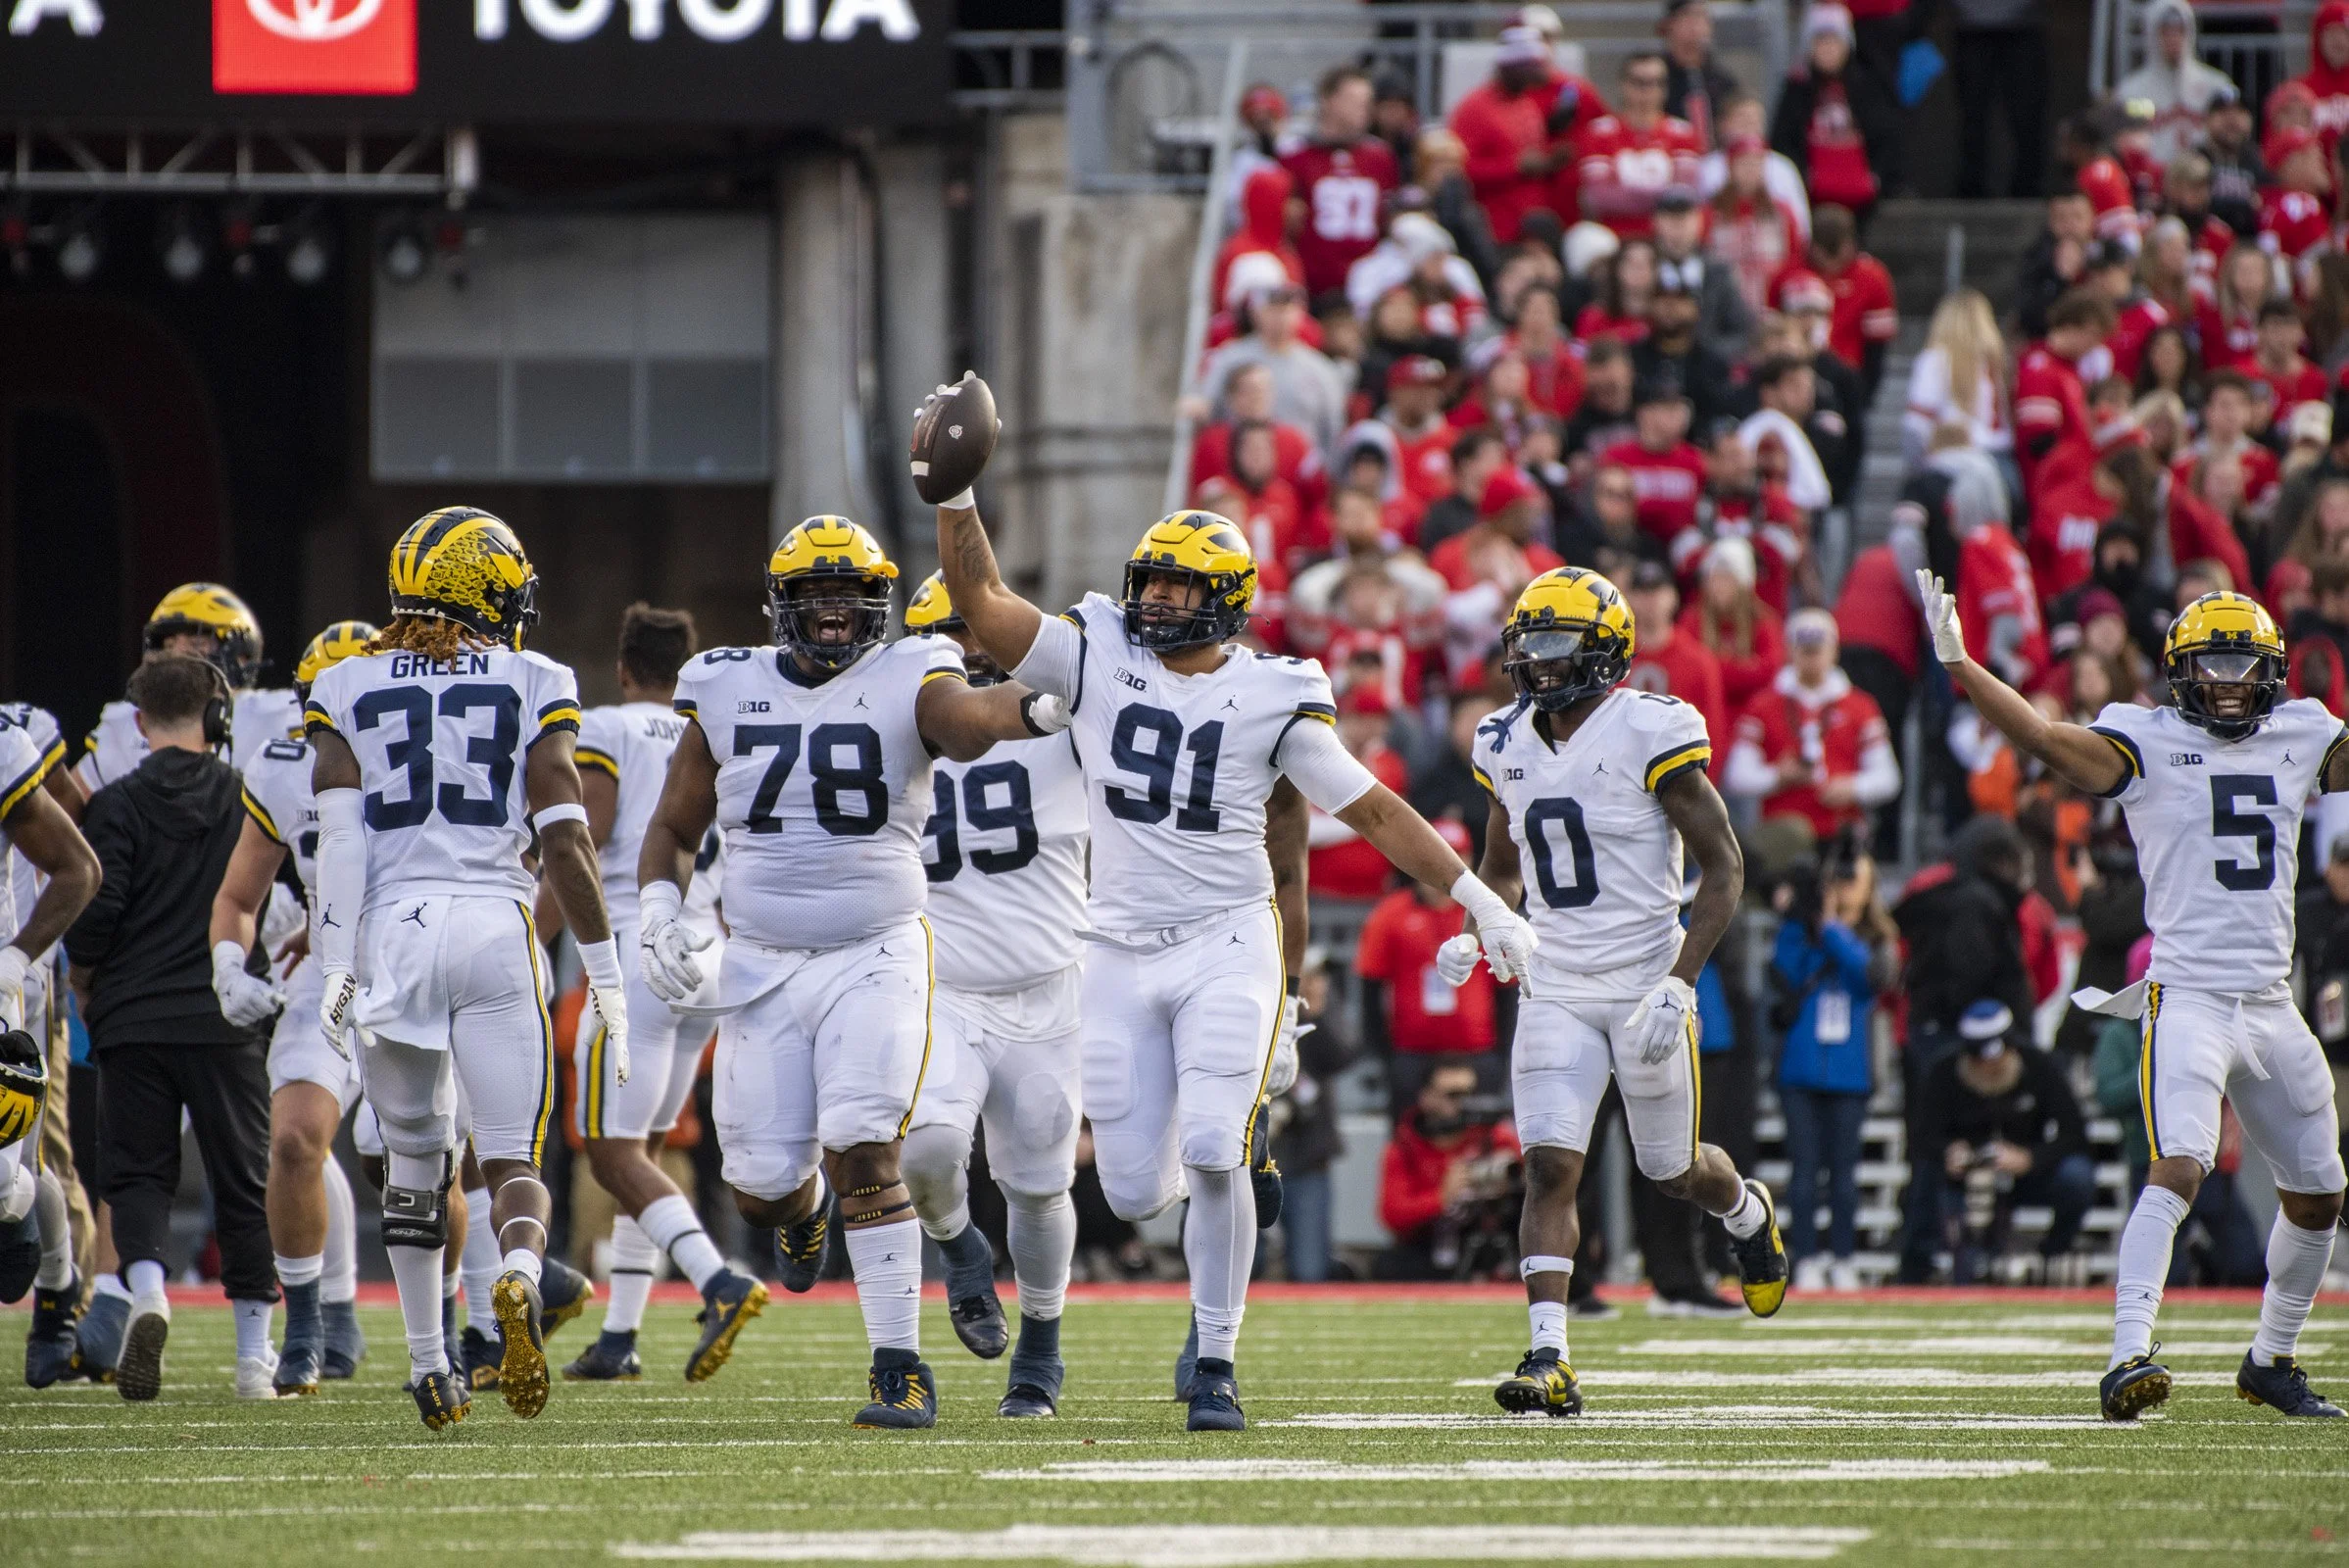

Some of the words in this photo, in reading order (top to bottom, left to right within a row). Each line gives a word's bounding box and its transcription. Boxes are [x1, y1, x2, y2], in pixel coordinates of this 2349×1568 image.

[474, 0, 919, 41] OOA
[390, 653, 489, 679] GREEN
[2226, 631, 2237, 640] M
[352, 683, 522, 832] 33
[732, 722, 889, 836] 78
[1103, 702, 1225, 833] 91
[1524, 796, 1601, 909] 0
[2209, 773, 2278, 892] 5
